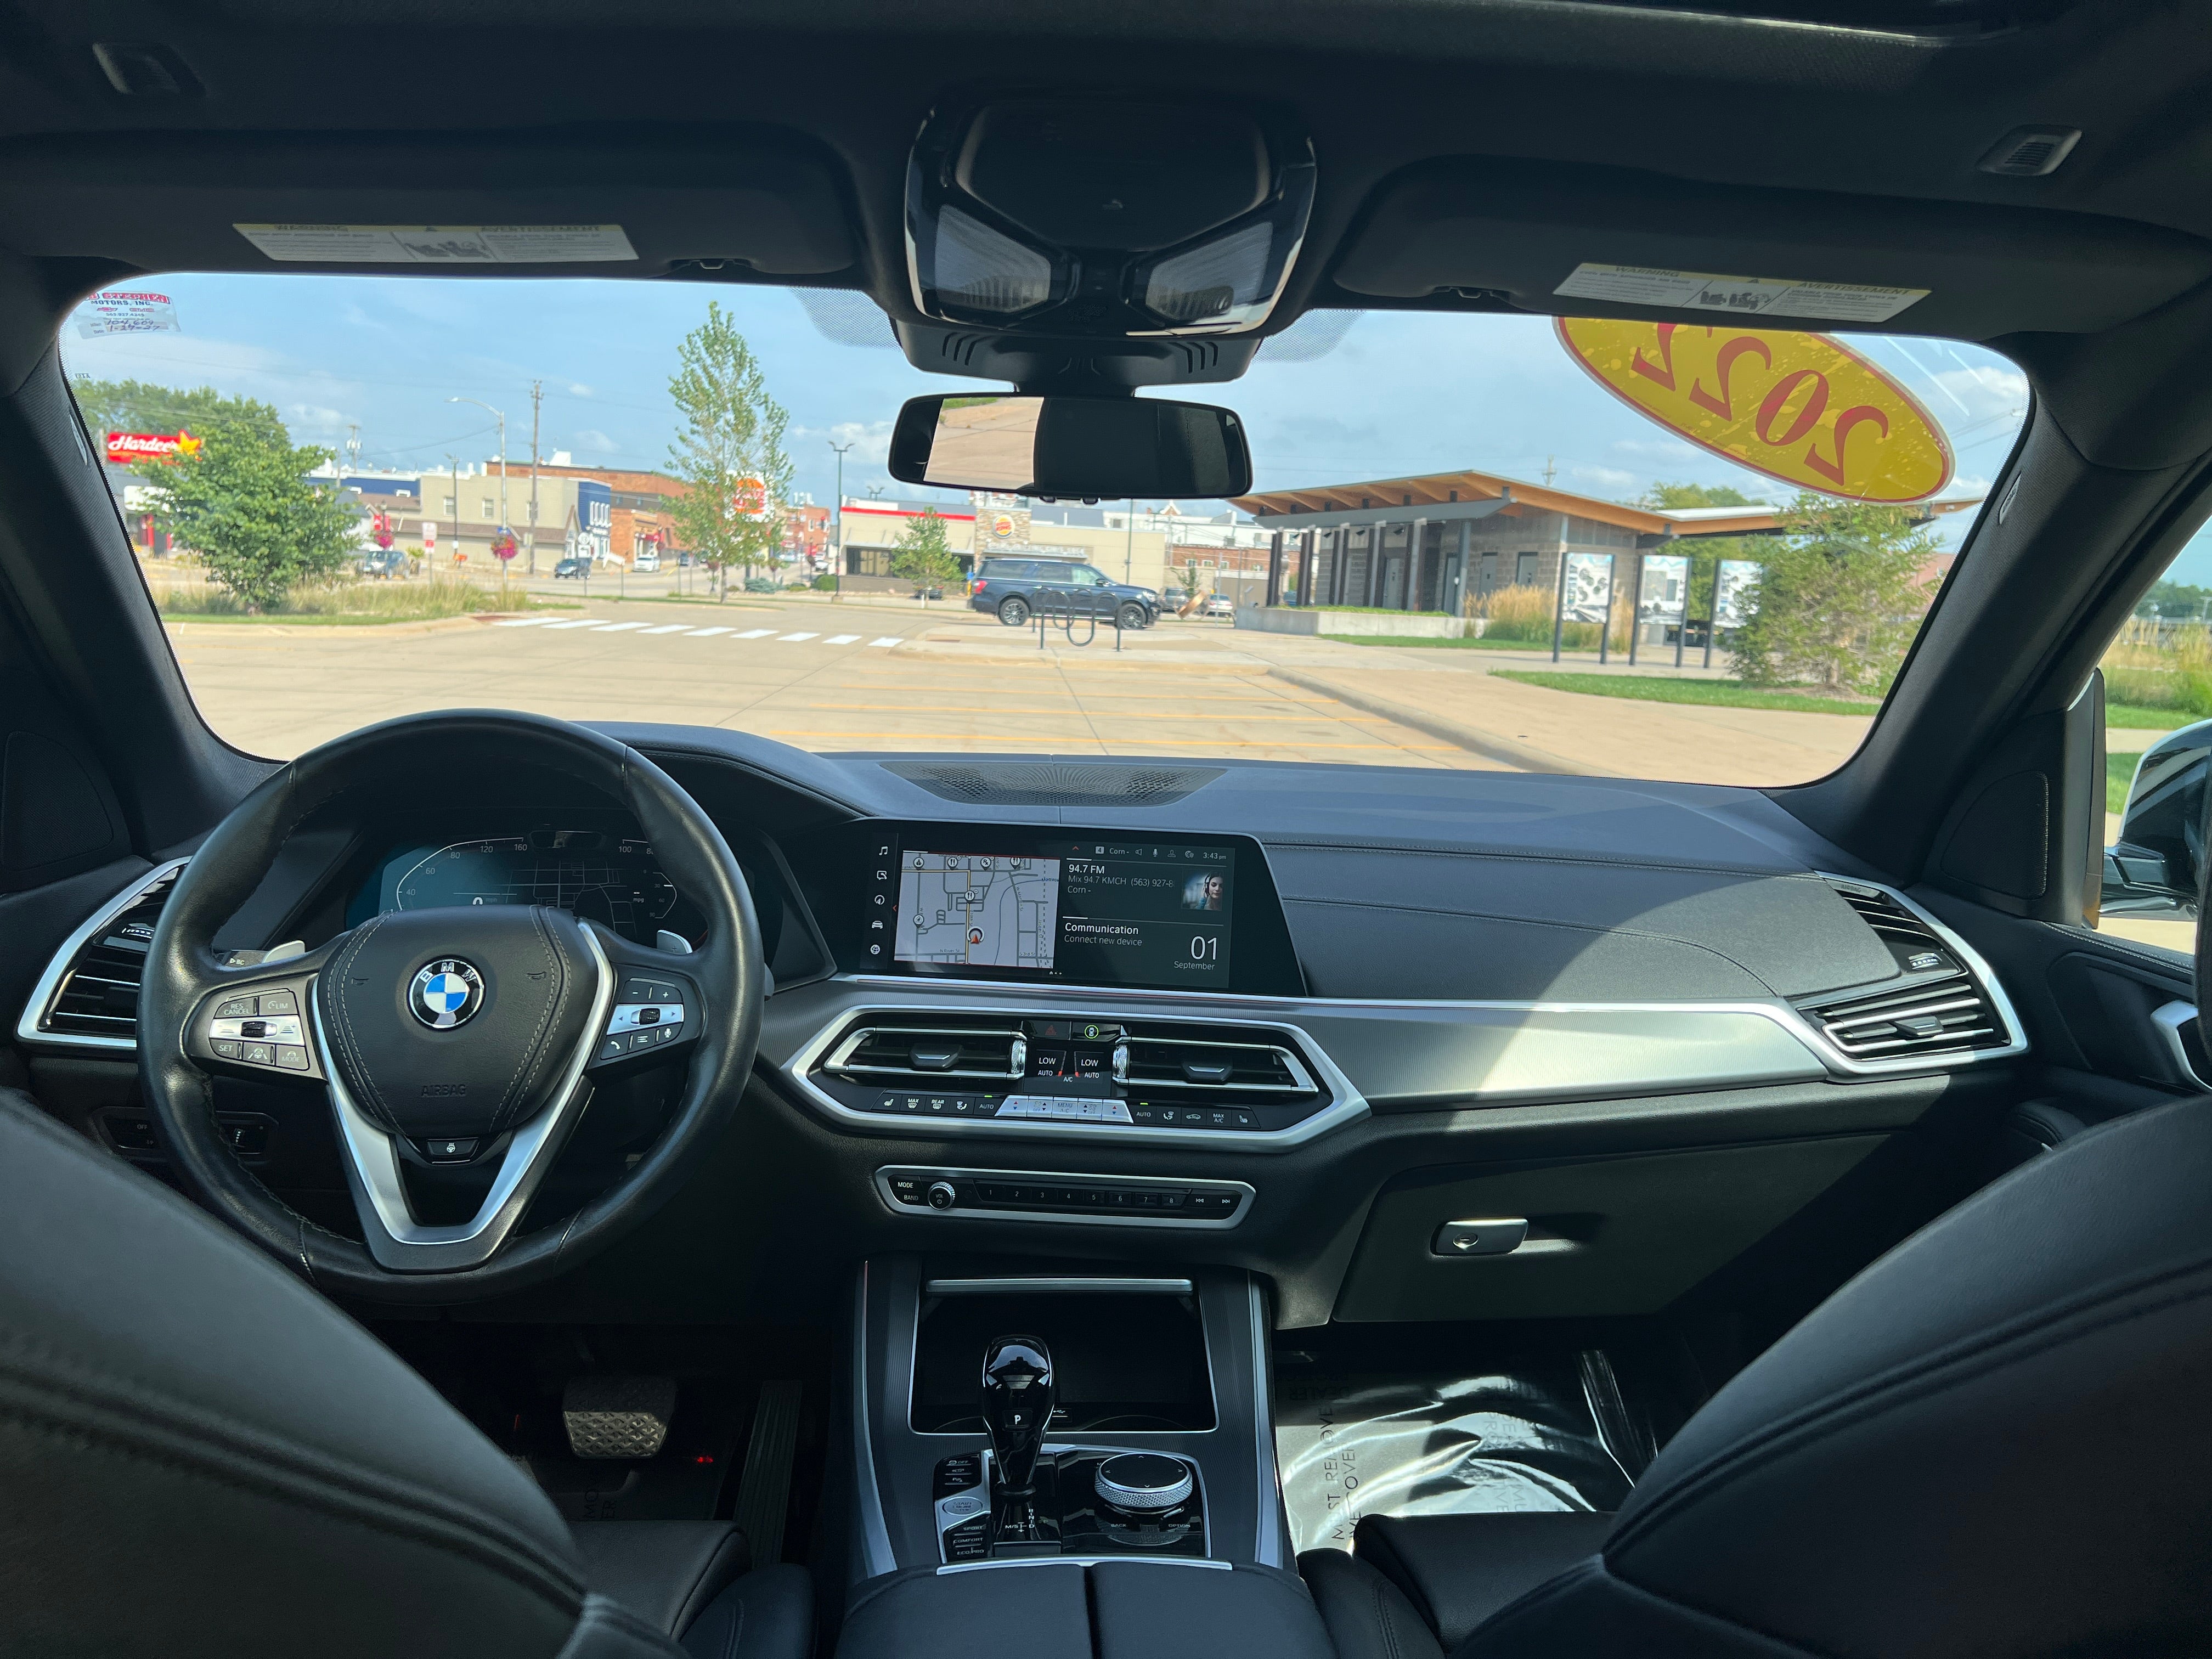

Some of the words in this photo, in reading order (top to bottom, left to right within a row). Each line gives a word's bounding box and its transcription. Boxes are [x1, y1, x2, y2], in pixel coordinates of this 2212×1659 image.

[1069, 864, 1088, 873] 94.7
[1090, 865, 1105, 874] FM
[1084, 876, 1099, 884] 94.7
[1130, 878, 1150, 887] (563)
[1065, 922, 1139, 935] Communication
[1064, 935, 1097, 944] Connect
[1116, 937, 1142, 946] device
[1191, 936, 1217, 960] 01
[1174, 961, 1215, 970] September
[420, 962, 477, 983] BMW
[1081, 1059, 1098, 1067] LOW
[1014, 1415, 1021, 1425] P
[1319, 1407, 1338, 1481] REOVE
[1328, 1493, 1345, 1539] MST
